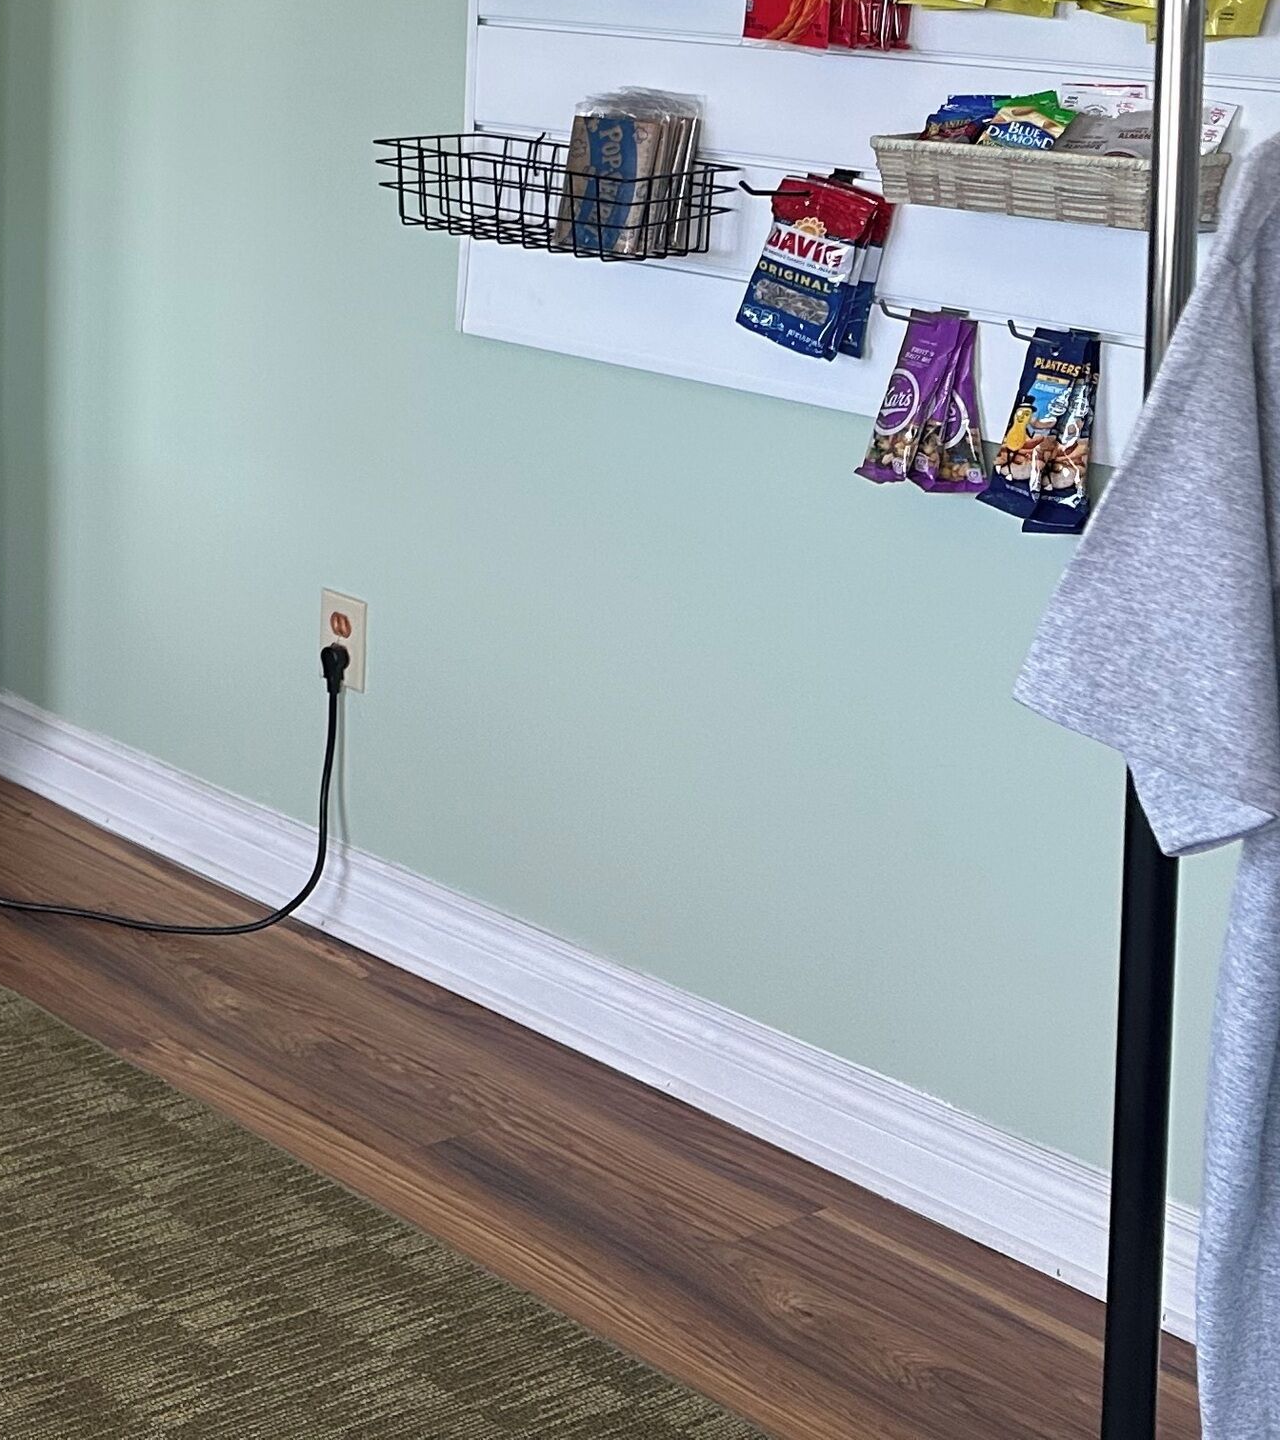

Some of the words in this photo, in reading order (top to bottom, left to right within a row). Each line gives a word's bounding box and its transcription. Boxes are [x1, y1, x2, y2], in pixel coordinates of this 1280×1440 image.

[985, 124, 1054, 150] DIAMOND
[1008, 121, 1042, 138] BLUE
[758, 259, 832, 294] ORIGINAL
[1033, 356, 1082, 377] PLANTERS
